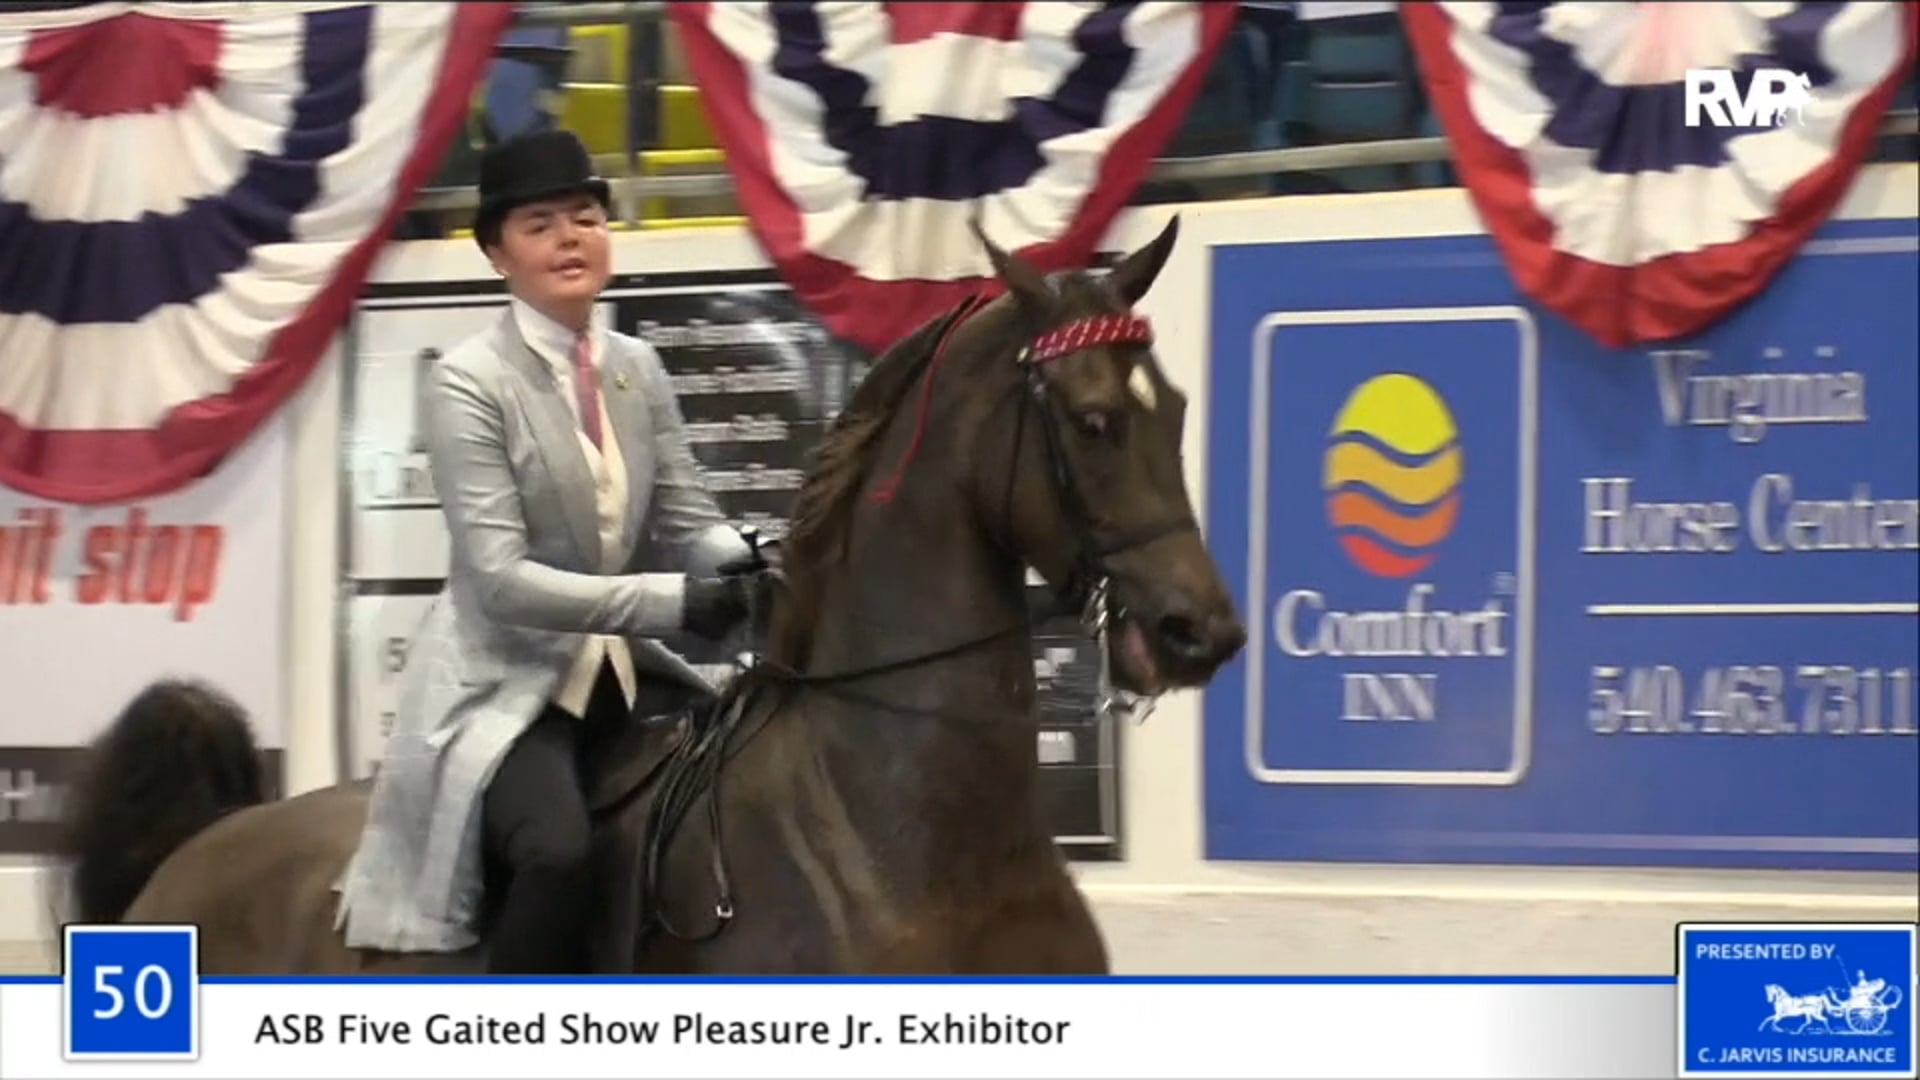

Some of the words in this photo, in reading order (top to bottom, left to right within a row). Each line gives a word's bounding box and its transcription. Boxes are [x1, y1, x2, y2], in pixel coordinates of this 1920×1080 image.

[1649, 346, 1868, 442] Virginia
[1581, 476, 1739, 553] Horse
[1749, 472, 1919, 552] Center
[76, 507, 226, 622] stop
[1274, 583, 1508, 657] Comfort
[1339, 672, 1438, 721] INN
[1588, 664, 1919, 735] 540.463.7311
